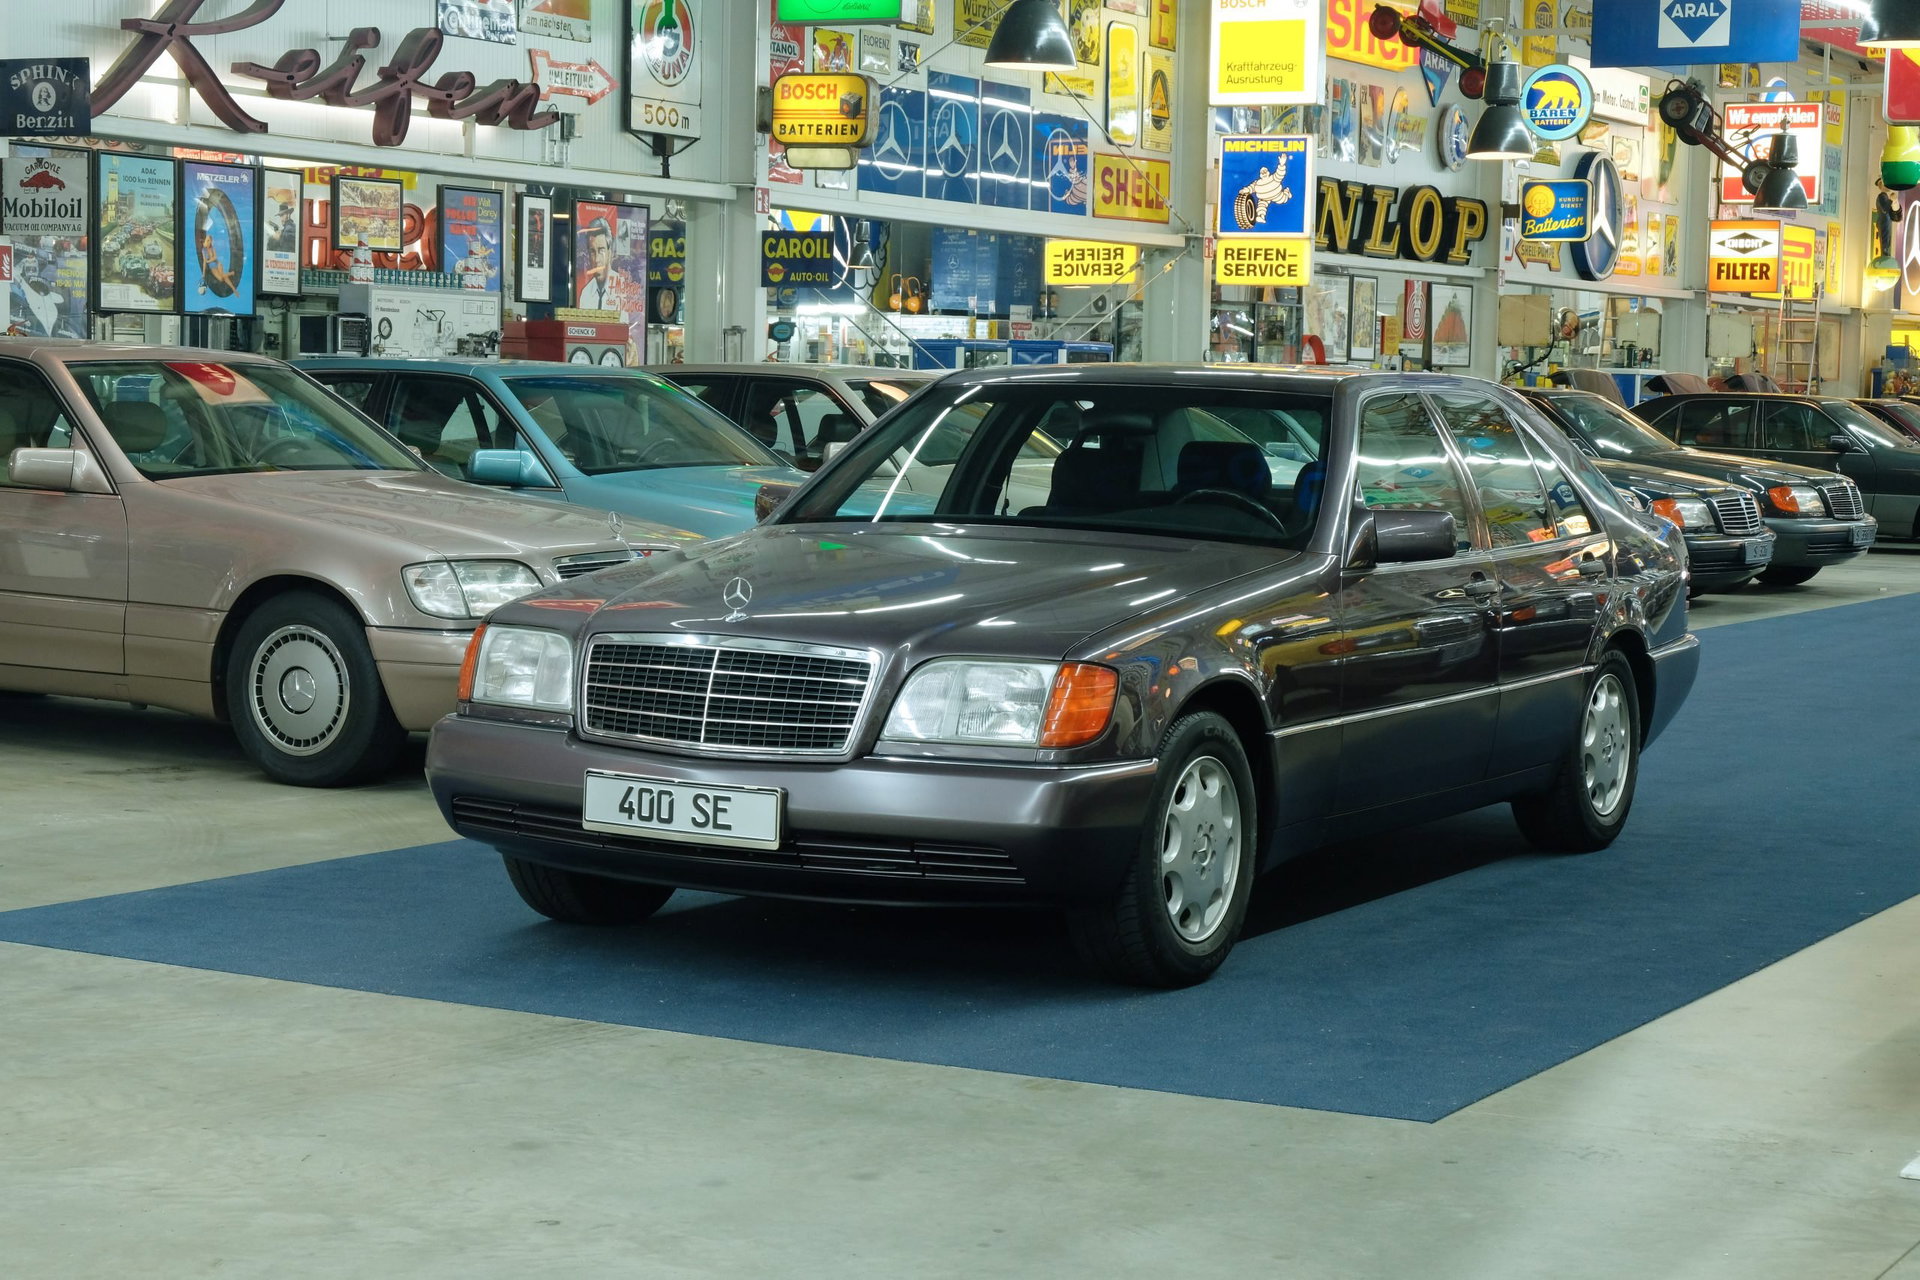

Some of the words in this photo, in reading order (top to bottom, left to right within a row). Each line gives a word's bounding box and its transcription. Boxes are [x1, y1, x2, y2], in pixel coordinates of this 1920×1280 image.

[1671, 2, 1720, 18] ARAL
[526, 15, 538, 26] am
[540, 16, 572, 32] nächsten
[770, 41, 797, 56] TANOL
[863, 35, 890, 50] FLORENZ
[1226, 61, 1297, 73] Kraftfahrzeug-
[780, 83, 838, 100] BOSCH
[16, 110, 75, 129] Benzin
[644, 104, 679, 128] 500
[681, 116, 690, 130] m
[1530, 108, 1577, 118] BÄREN
[1728, 109, 1749, 125] Wir
[1534, 118, 1572, 126] BATTERIE
[778, 124, 859, 136] BATTERIEN
[1224, 140, 1305, 152] MICHELIN
[141, 167, 157, 175] ADAC
[197, 172, 240, 184] METZELER
[147, 177, 171, 186] RENNEN
[1101, 166, 1164, 210] SHELL
[3, 197, 82, 219] Mobiloil
[1316, 176, 1488, 265] NLOP
[1524, 214, 1585, 236] Batterien
[764, 237, 830, 259] CAROIL
[1223, 248, 1298, 261] REIFEN-
[789, 272, 829, 283] AUTO-OIL
[1223, 264, 1298, 278] SERVICE
[1716, 262, 1771, 281] FILTER
[568, 328, 590, 336] SCHENCK
[618, 785, 675, 824] 400
[691, 793, 732, 831] SE
